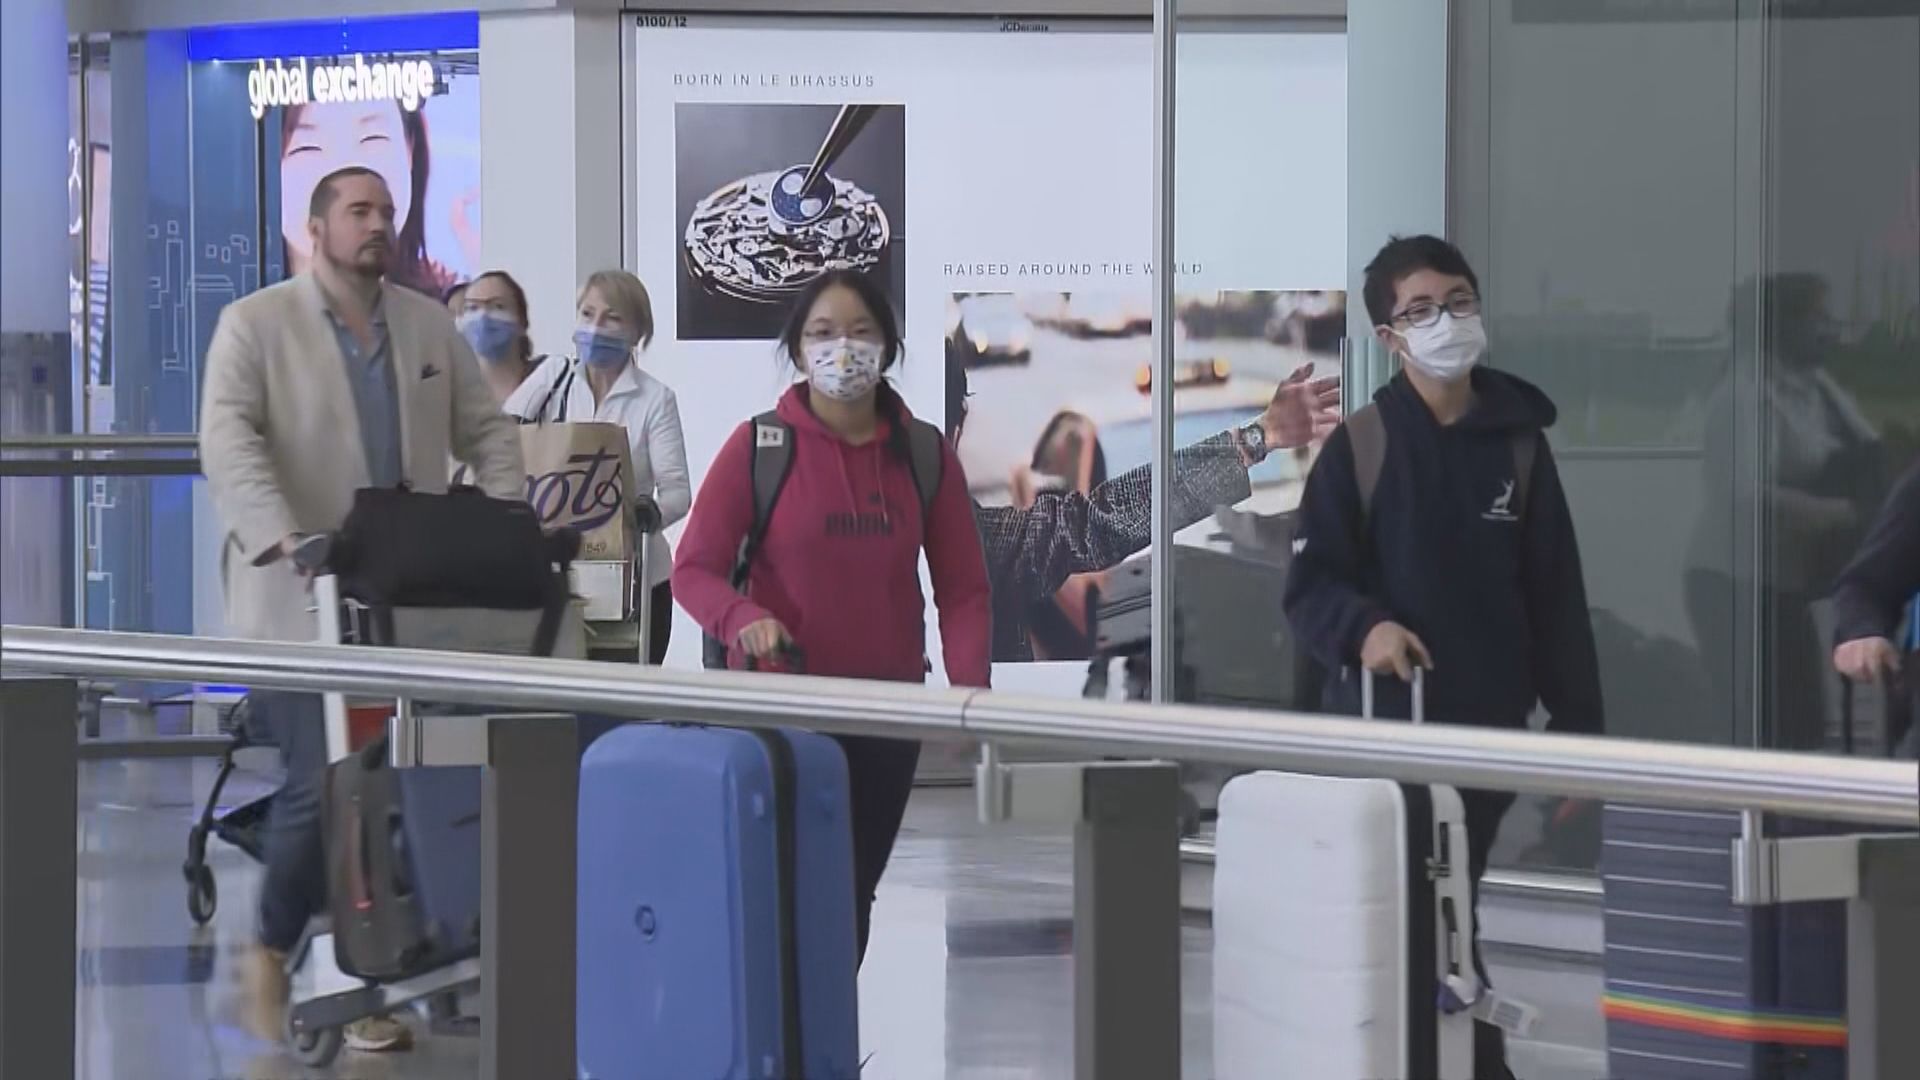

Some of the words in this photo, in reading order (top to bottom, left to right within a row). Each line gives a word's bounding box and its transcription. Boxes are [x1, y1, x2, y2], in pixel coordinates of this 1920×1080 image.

[248, 56, 308, 119] global
[312, 53, 433, 111] exchange
[673, 73, 722, 86] BORN
[733, 73, 749, 86] IN
[760, 74, 780, 87] LE
[943, 263, 1009, 276] RAISED
[1018, 263, 1092, 276] AROUND
[1103, 264, 1133, 276] THE
[1143, 264, 1202, 276] WLD
[525, 447, 623, 532] ots
